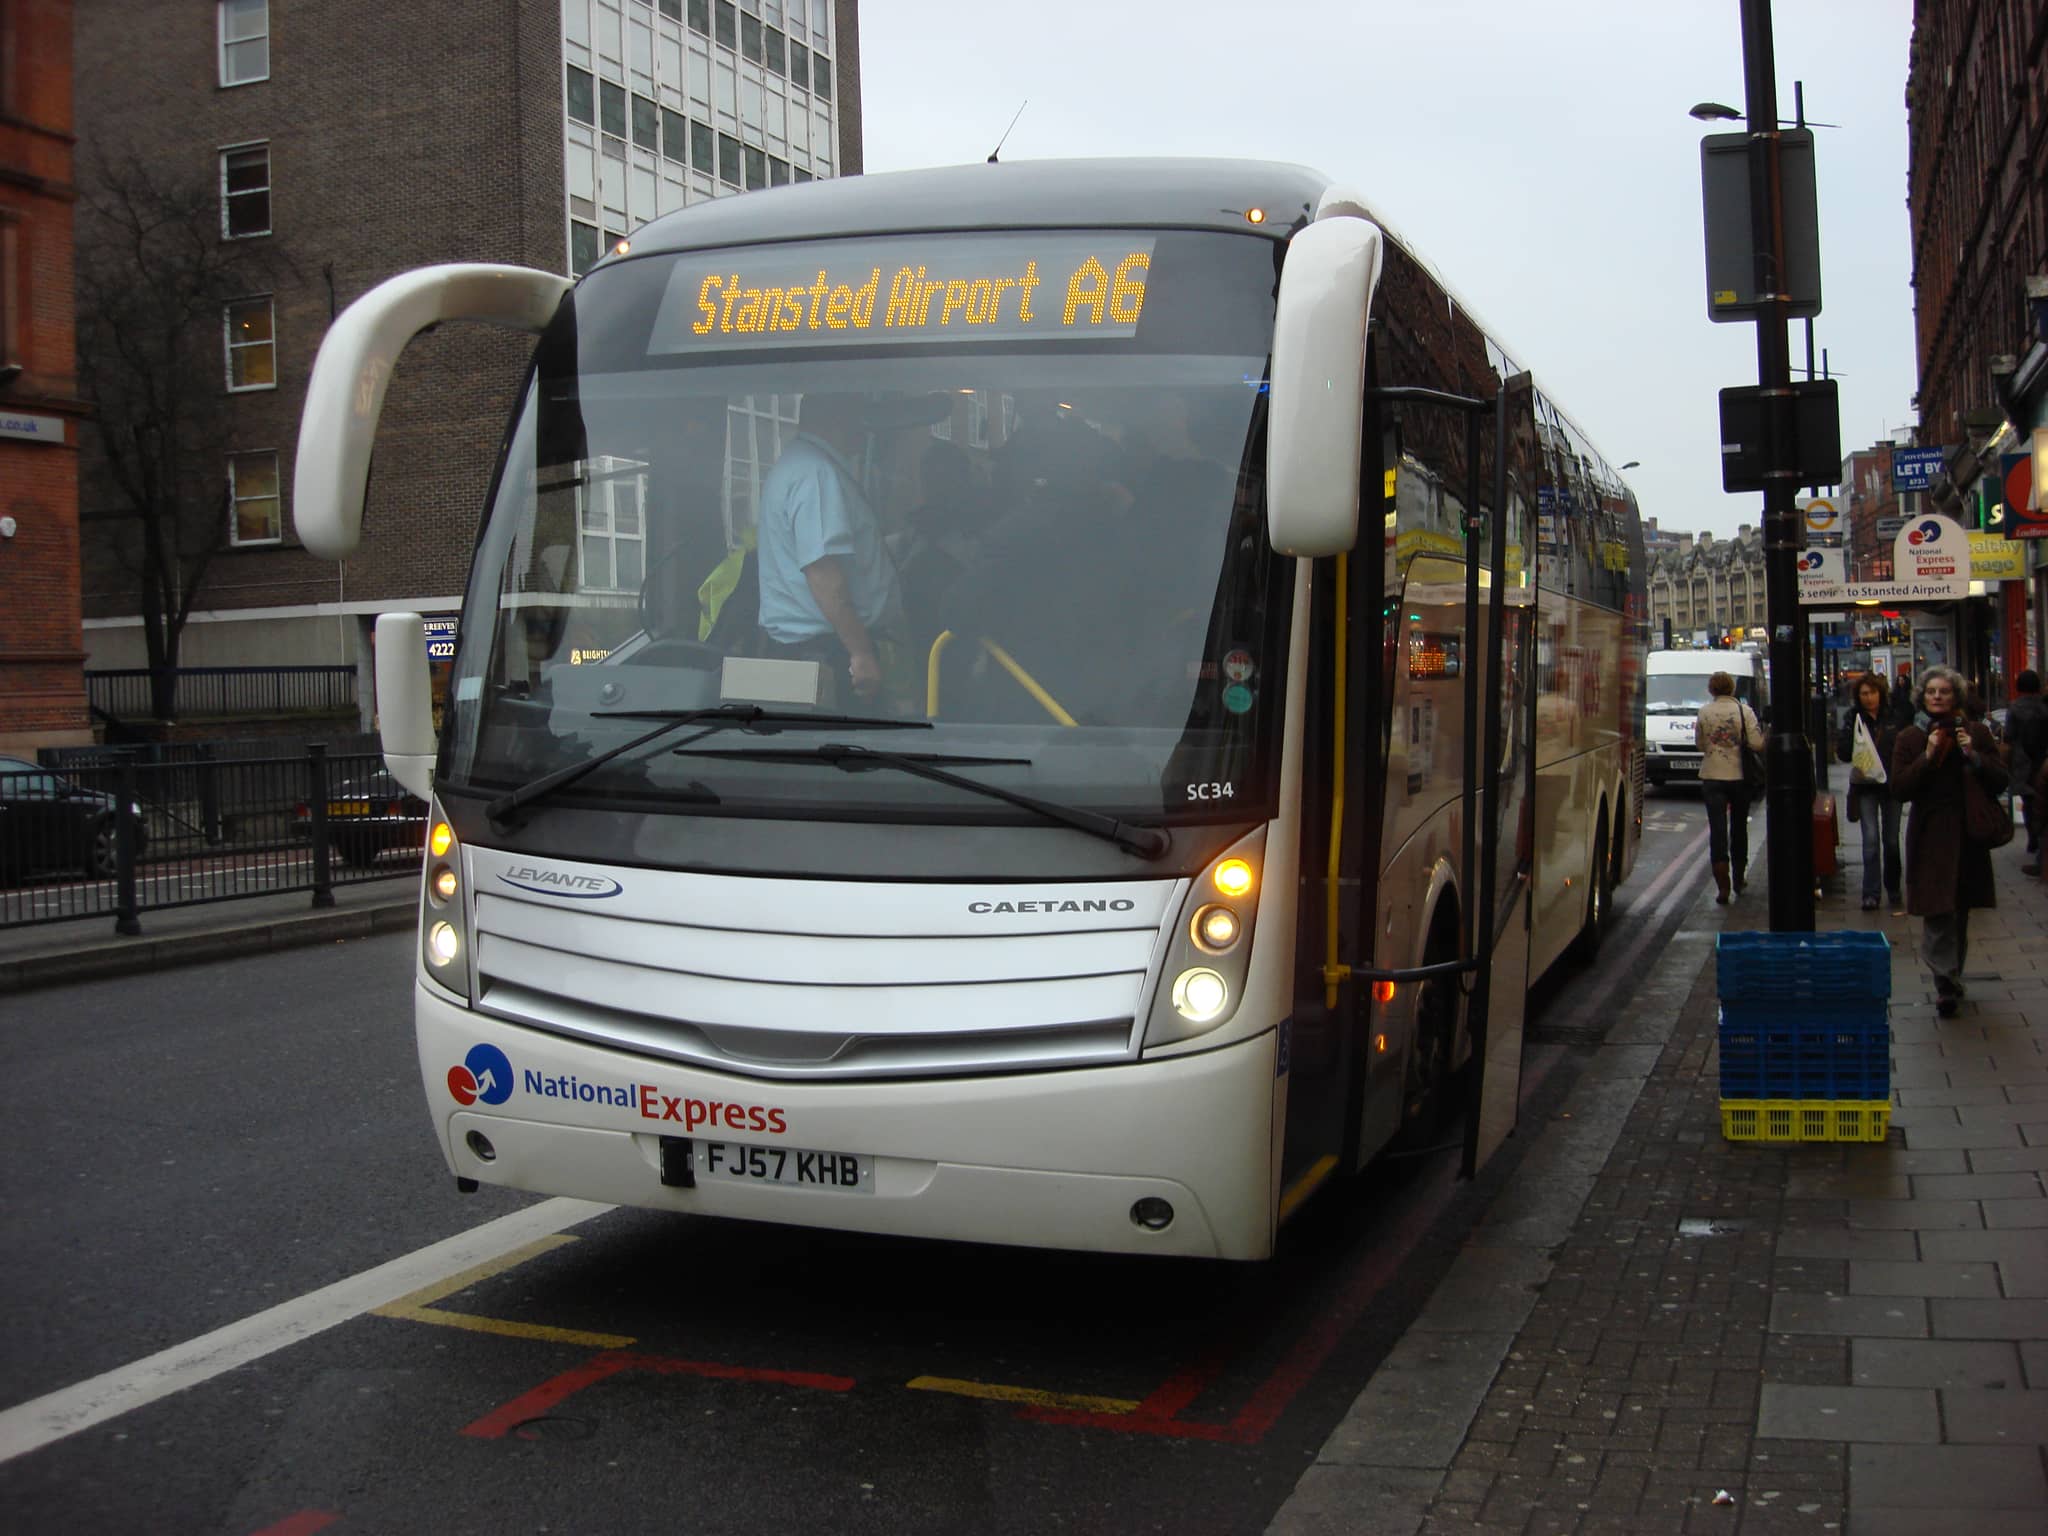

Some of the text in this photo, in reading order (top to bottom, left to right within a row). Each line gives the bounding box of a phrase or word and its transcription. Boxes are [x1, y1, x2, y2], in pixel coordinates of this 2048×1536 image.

[692, 252, 1152, 335] Stansted Airport A6
[1896, 461, 1941, 476] LET BY
[1916, 556, 1954, 565] Express
[1848, 587, 1859, 597] to
[1861, 585, 1909, 597] Stansted
[1912, 584, 1951, 597] Airport
[428, 642, 455, 656] 4222
[1187, 782, 1234, 801] SC34
[506, 866, 605, 890] LEVANTE
[968, 899, 1135, 914] CAETANO
[524, 1069, 787, 1134] National Express
[707, 1143, 859, 1186] FJ57 KHB
